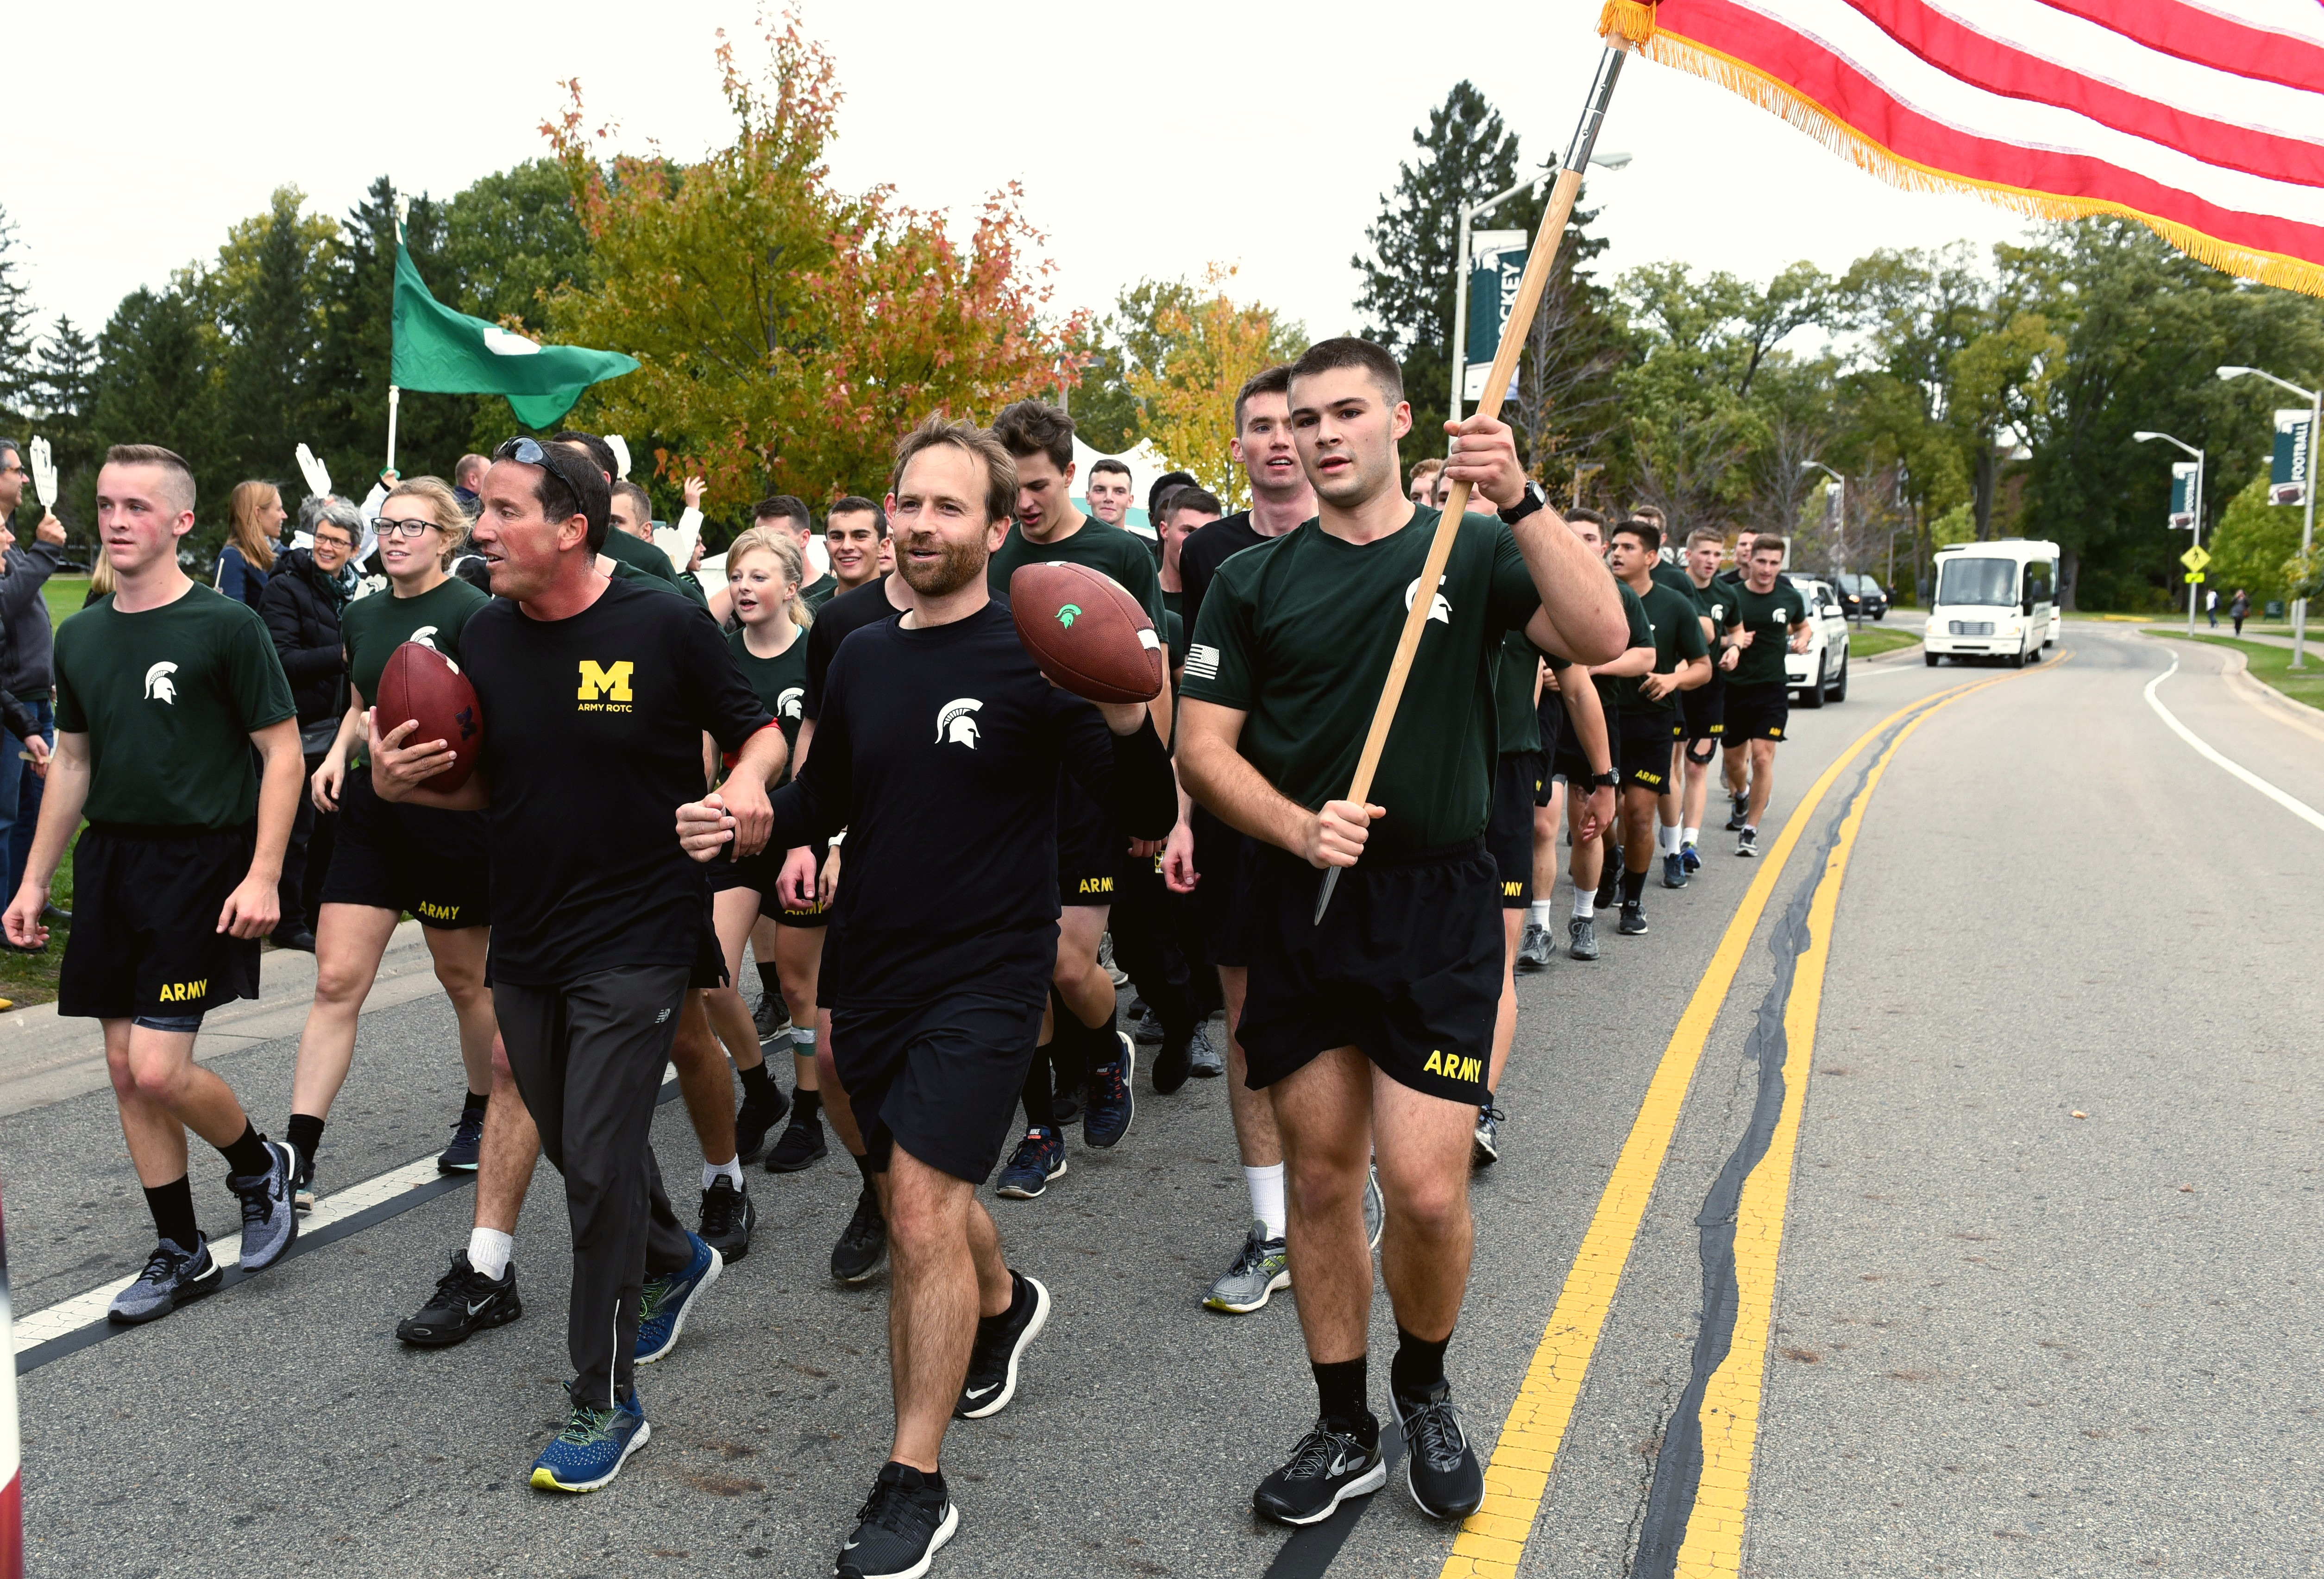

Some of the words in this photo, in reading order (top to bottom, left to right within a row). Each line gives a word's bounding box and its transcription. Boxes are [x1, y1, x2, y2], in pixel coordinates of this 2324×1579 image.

[2290, 422, 2309, 481] FOOTBALL
[578, 660, 634, 702] M
[606, 704, 633, 712] ROTC
[1634, 769, 1662, 785] ARMY
[418, 900, 460, 920] ARMY
[159, 978, 207, 1002] ARMY
[1423, 1050, 1482, 1083] ARMY
